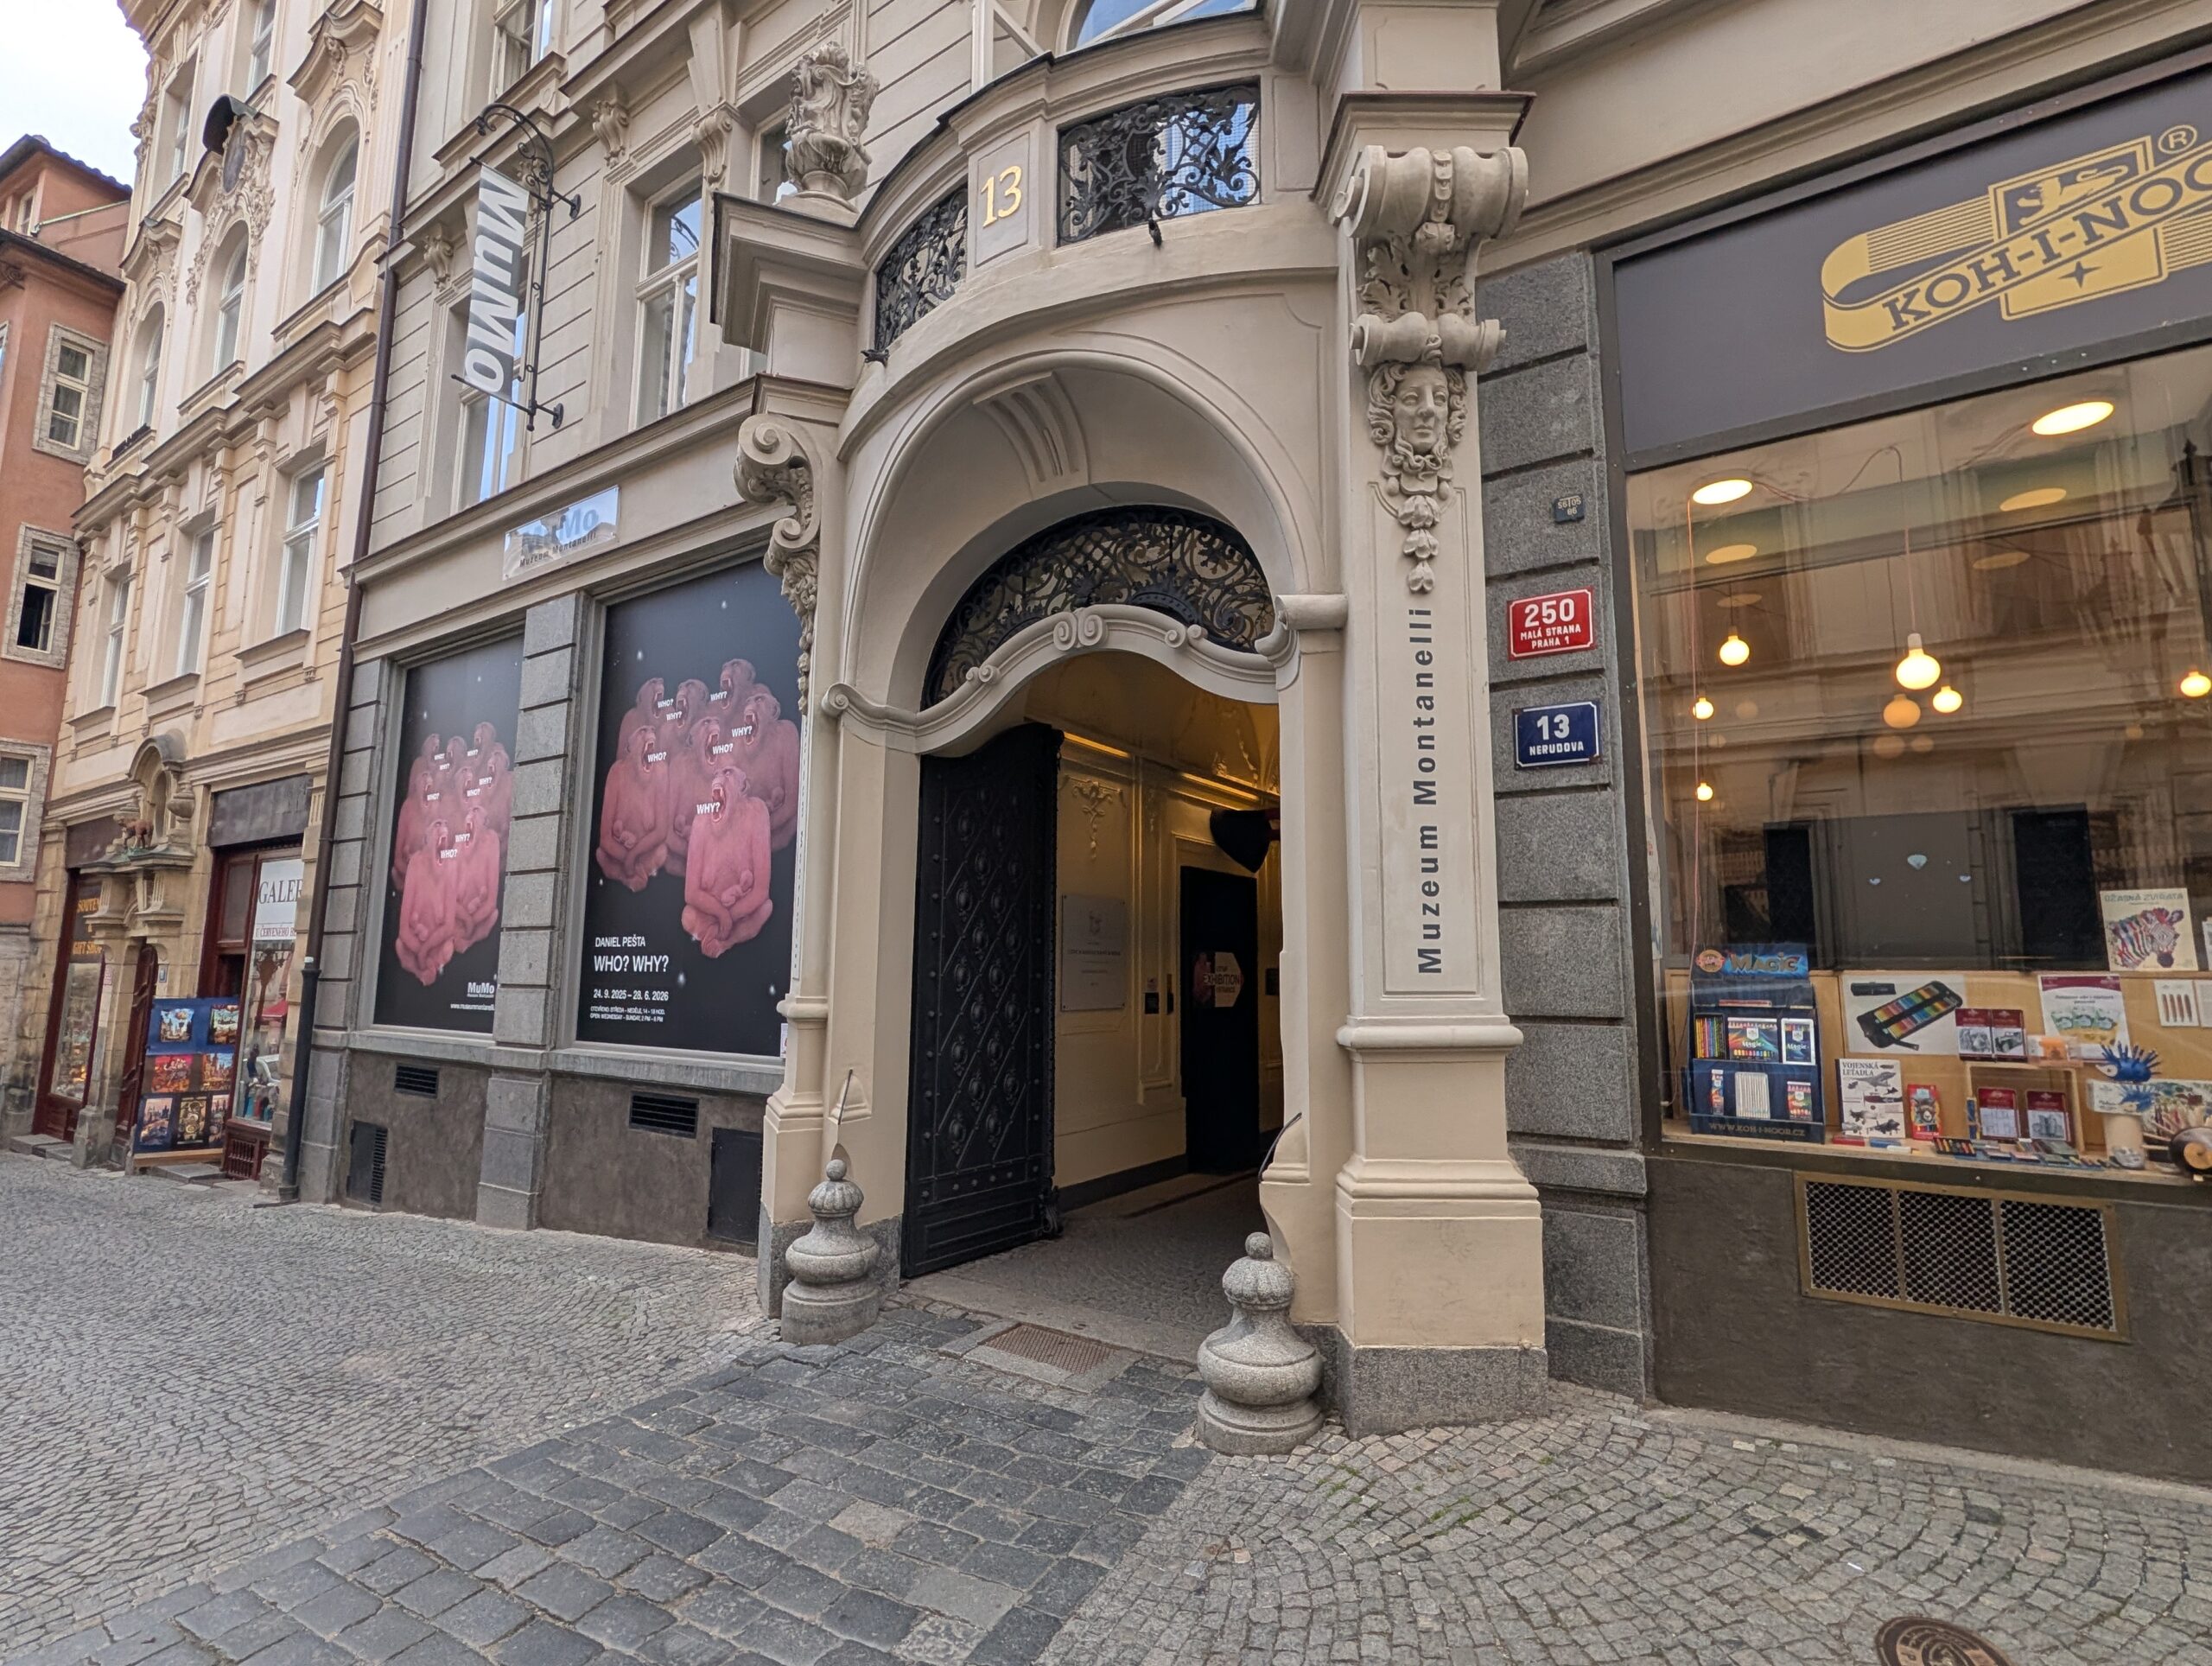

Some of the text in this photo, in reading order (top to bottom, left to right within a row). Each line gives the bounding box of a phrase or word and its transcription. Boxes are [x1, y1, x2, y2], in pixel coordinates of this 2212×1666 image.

[980, 165, 1022, 228] 13
[465, 165, 530, 394] MuMo
[1524, 598, 1575, 627] 250
[1521, 624, 1581, 641] MALÁ STRANA
[1531, 636, 1570, 649] PRAHA 1
[658, 698, 674, 708] WHO?
[710, 691, 728, 702] WHY?
[666, 711, 683, 721] WHY?
[731, 726, 753, 737] WHY?
[1536, 714, 1570, 740] 13
[712, 743, 734, 754] WHO?
[1529, 741, 1584, 756] NERUDOVA
[647, 752, 667, 763] WHO?
[1408, 608, 1442, 974] Muzeum Montanelli
[696, 802, 721, 815] WHY?
[454, 833, 470, 843] WHY?
[440, 849, 458, 858] WHO?
[594, 934, 645, 948] DANIEL PEŠTA
[594, 955, 669, 972] WHO? WHY?
[1203, 973, 1241, 986] EXHIBITION
[467, 982, 495, 994] MuMo
[593, 989, 603, 999] 24.
[604, 989, 610, 999] 9.
[611, 989, 626, 1000] 2025
[652, 991, 669, 1002] 2026
